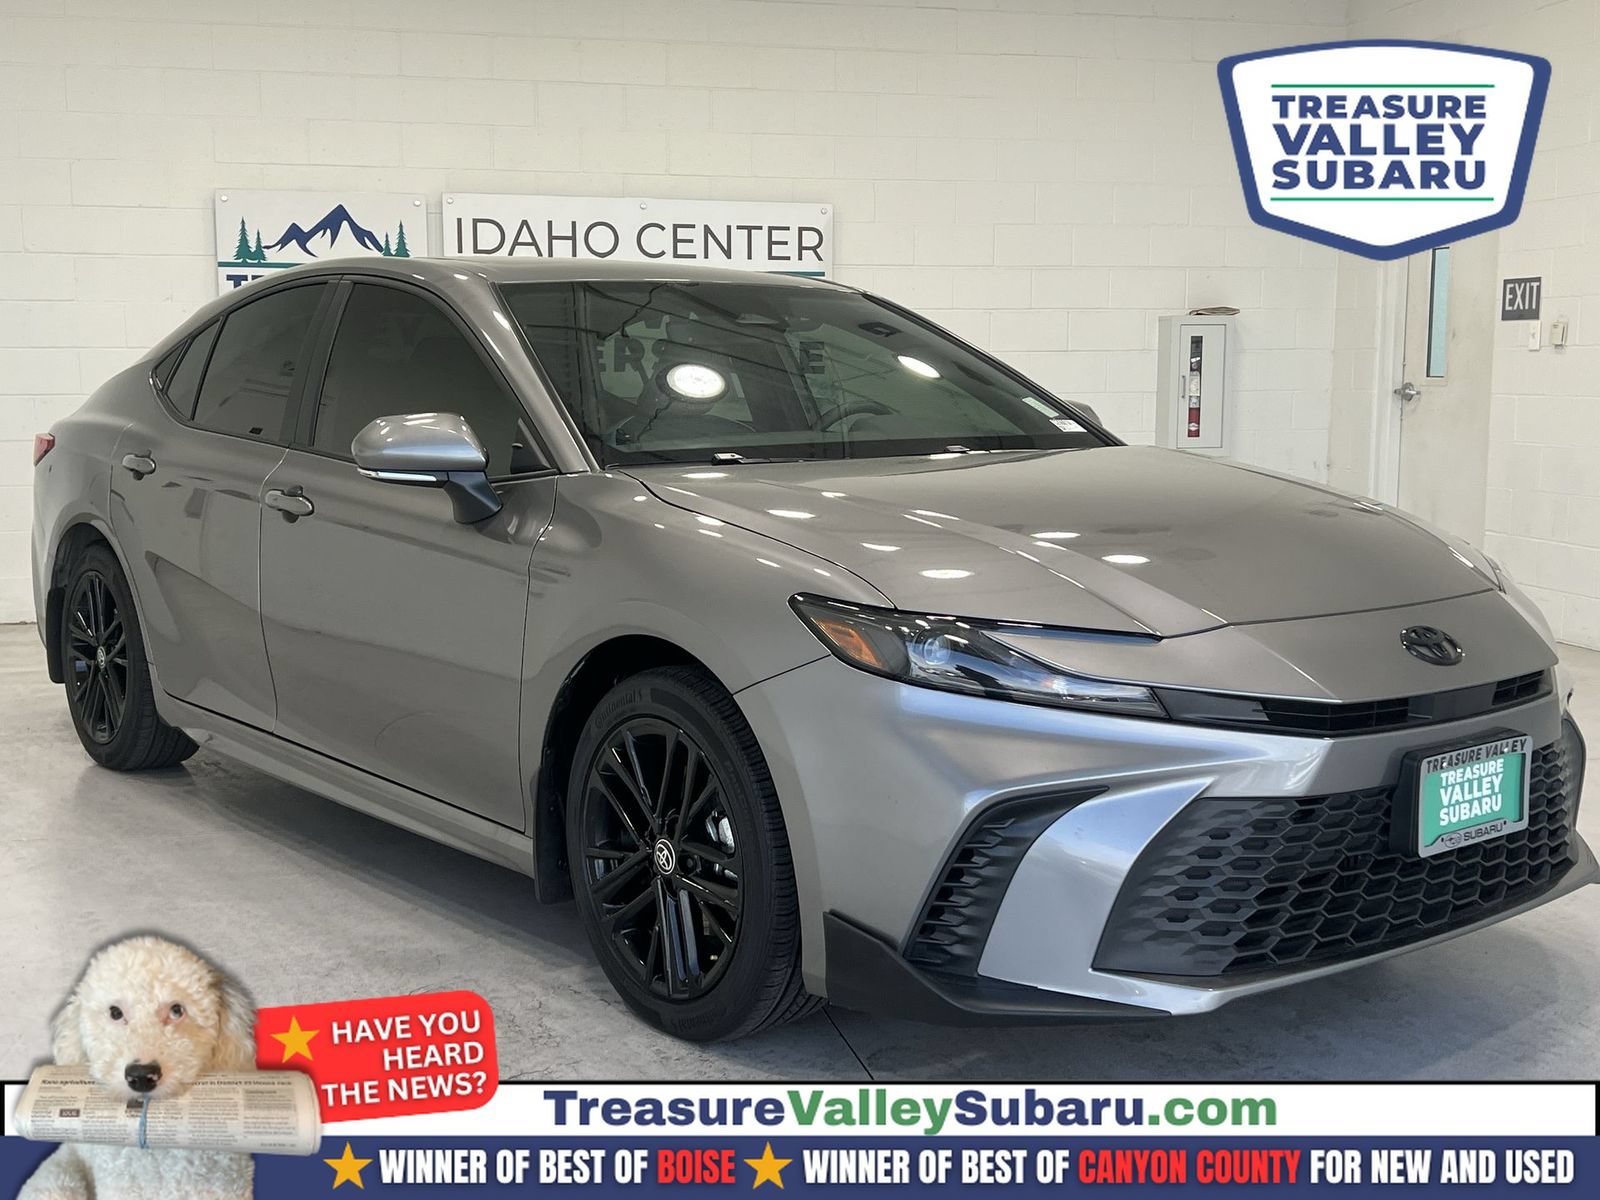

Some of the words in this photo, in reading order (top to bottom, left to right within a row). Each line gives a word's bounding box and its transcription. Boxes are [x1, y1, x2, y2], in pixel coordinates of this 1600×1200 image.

[456, 217, 620, 258] IDAHO
[636, 222, 824, 262] CENTER
[1505, 282, 1540, 311] EXIT
[1426, 748, 1482, 773] TREASURE
[1440, 758, 1504, 787] TREASURE
[1439, 773, 1503, 806] VALLEY
[1439, 793, 1502, 826] SUBARU
[1463, 822, 1503, 841] SUBARU
